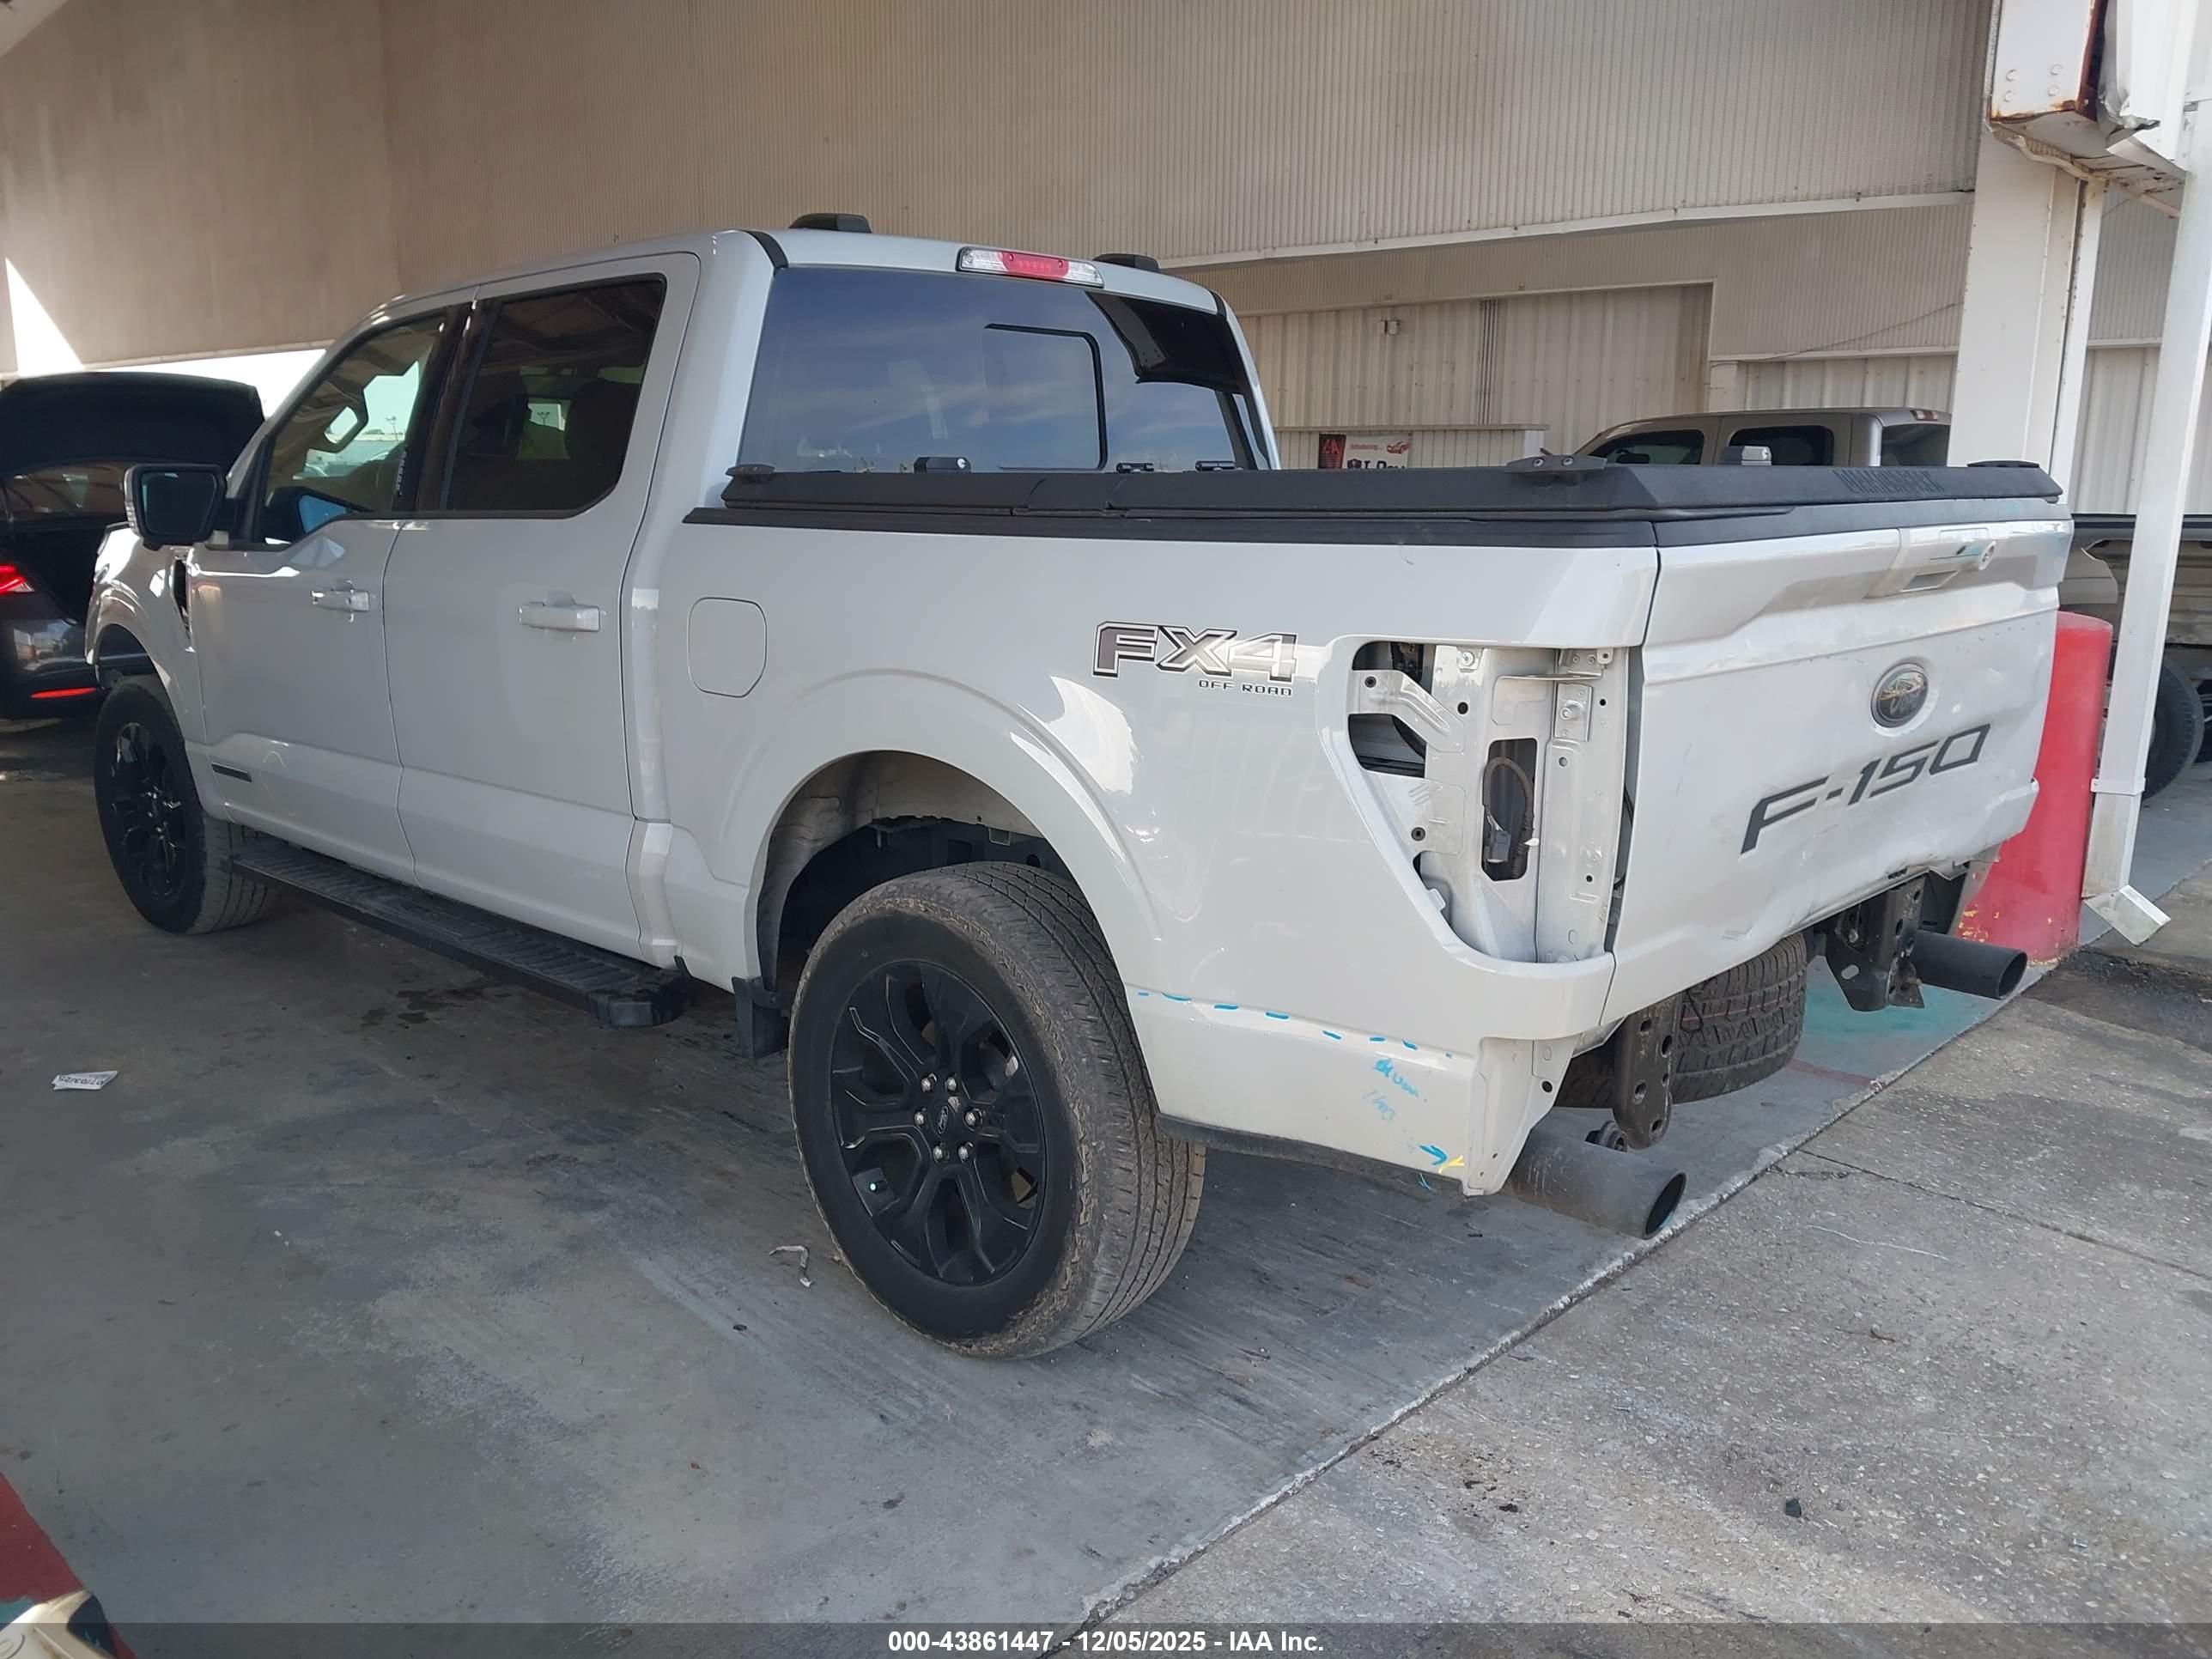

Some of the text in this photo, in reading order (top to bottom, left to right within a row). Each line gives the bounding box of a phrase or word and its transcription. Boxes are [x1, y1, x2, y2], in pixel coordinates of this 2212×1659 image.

[1093, 621, 1297, 683] FX4
[1199, 679, 1292, 696] OFF ROAD
[1740, 723, 1991, 855] F-150
